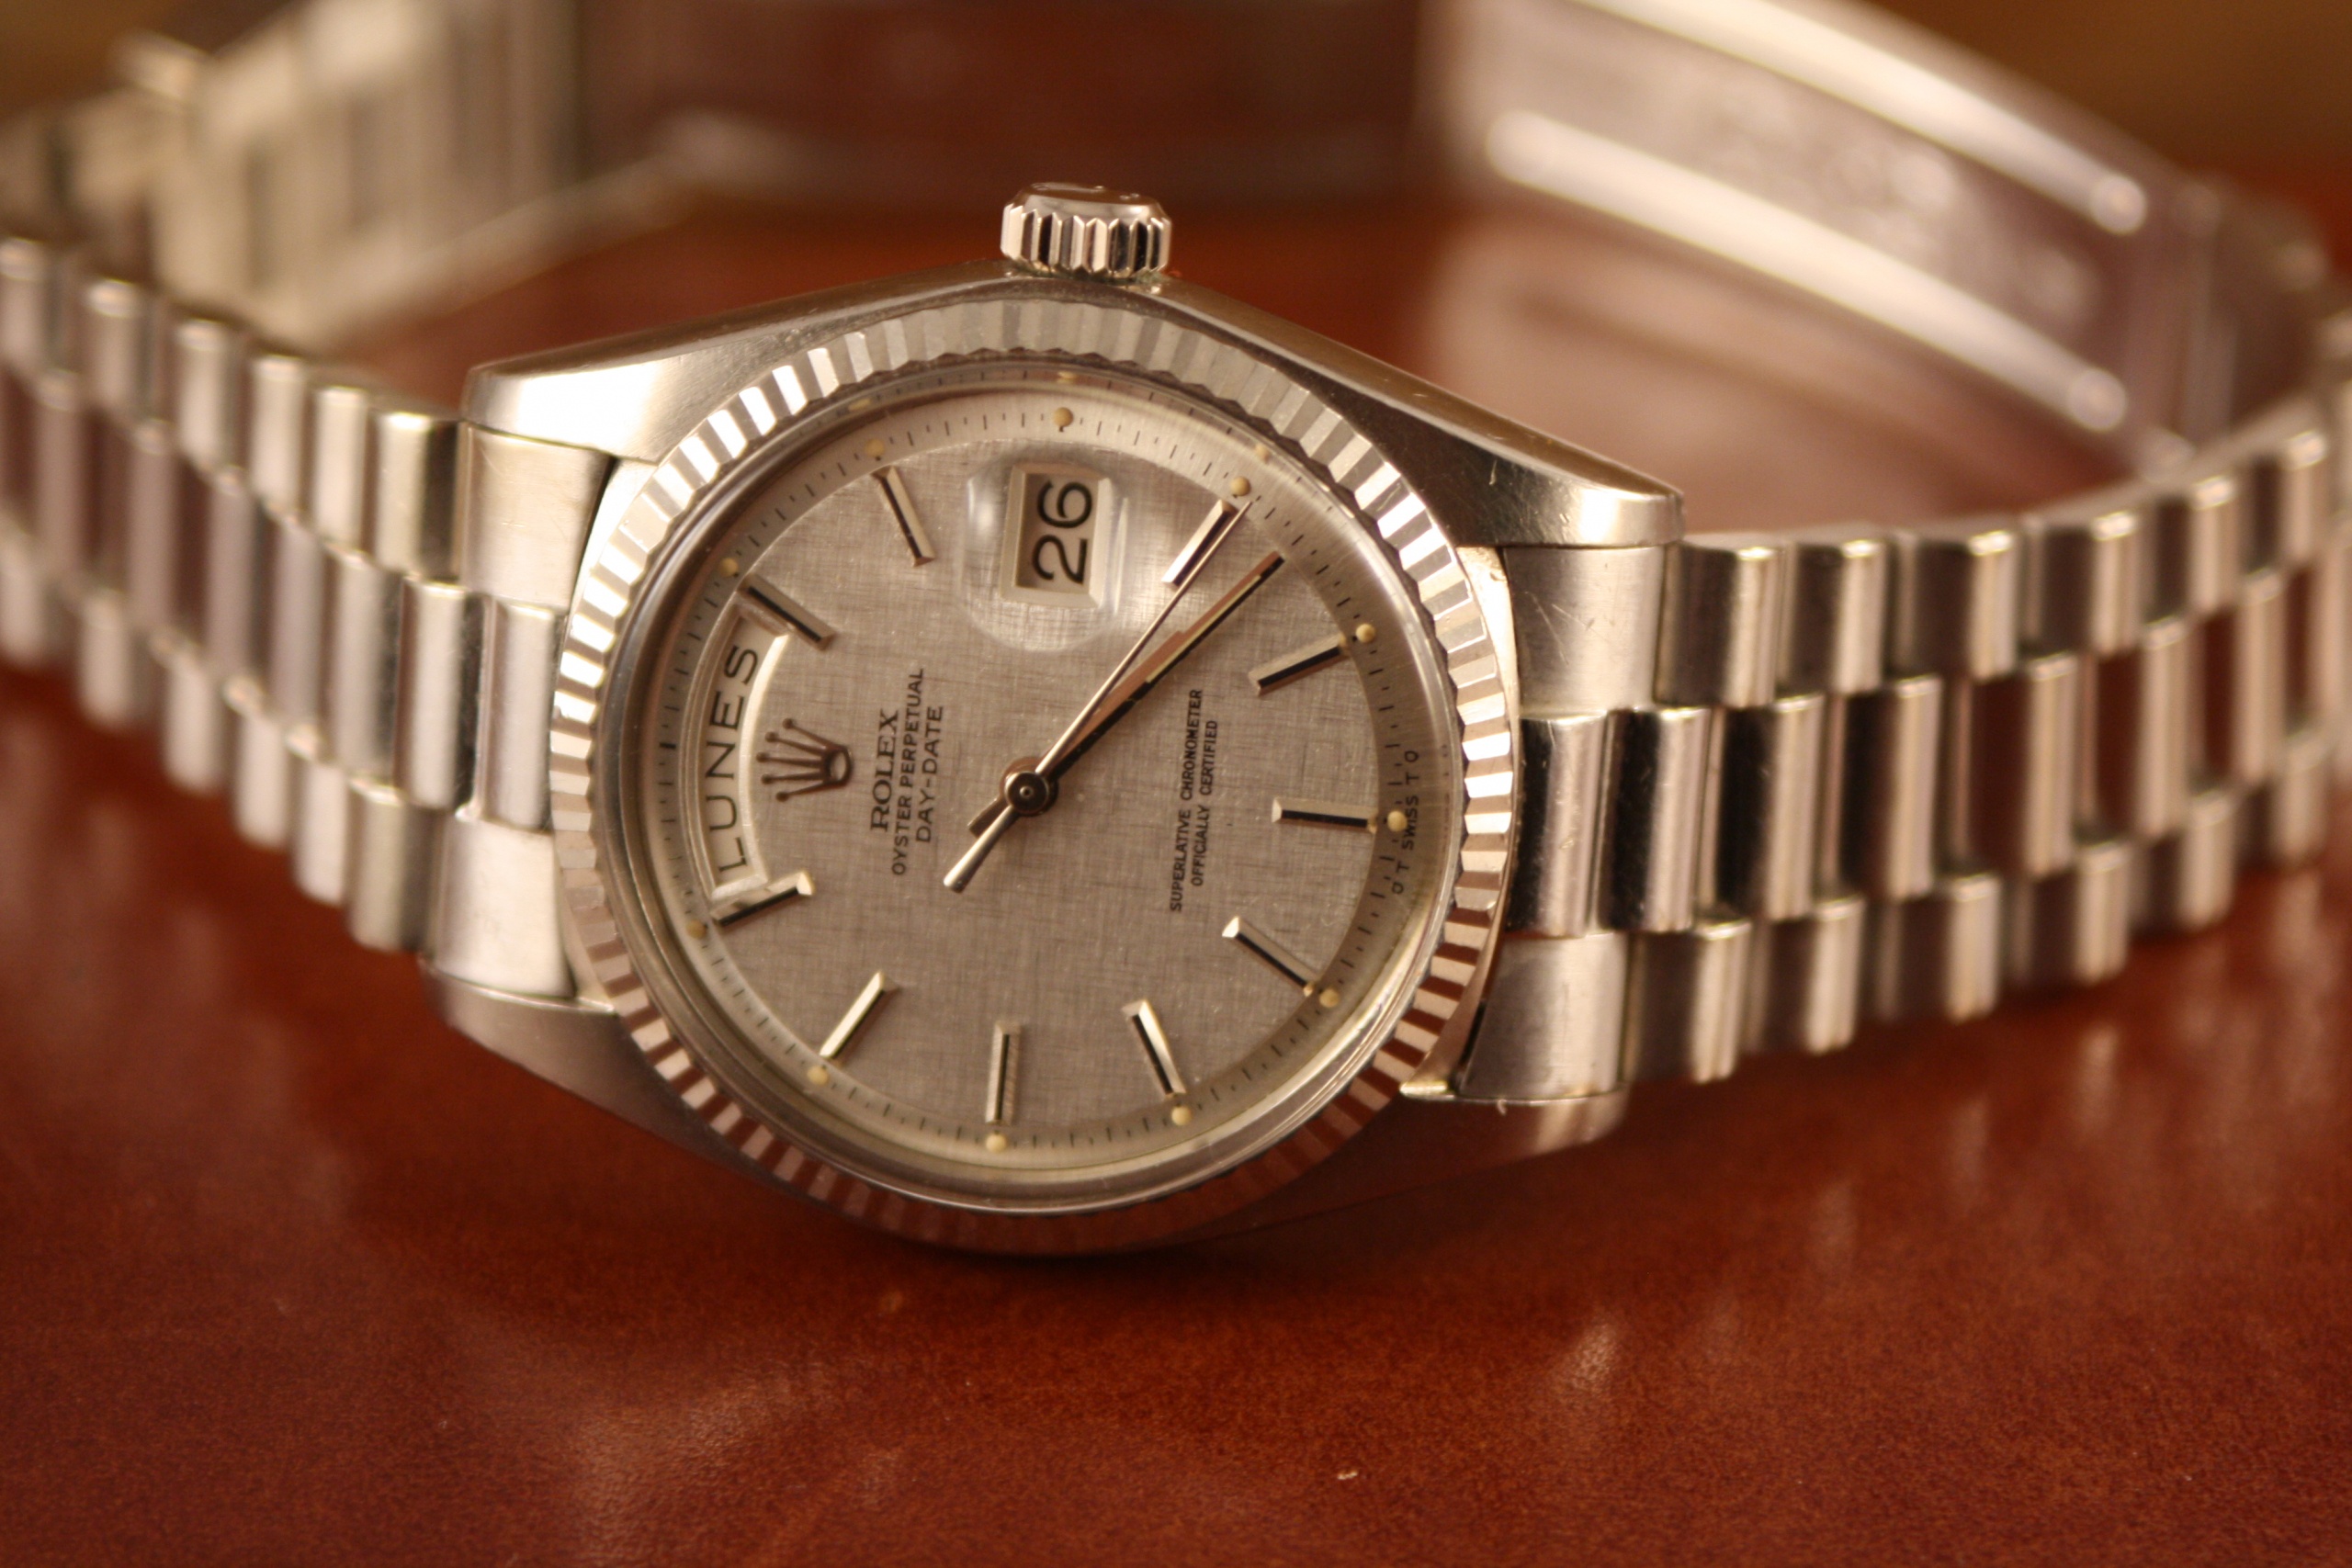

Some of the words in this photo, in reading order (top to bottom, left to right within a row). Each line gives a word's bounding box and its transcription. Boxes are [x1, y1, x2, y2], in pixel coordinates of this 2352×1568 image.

[1032, 480, 1092, 584] 26
[706, 645, 758, 872] LUNES
[871, 709, 898, 831] ROLEX
[899, 669, 923, 787] PERPETUAL
[916, 706, 943, 842] DAY-DATE
[1200, 720, 1217, 795] CERTIFIED
[891, 795, 912, 875] OYSTER
[1170, 809, 1192, 912] SUPERLATIVE
[1181, 689, 1203, 801] CHRONOMETER
[1192, 805, 1211, 887] OFFICIALLY
[1402, 795, 1419, 851] SWISS
